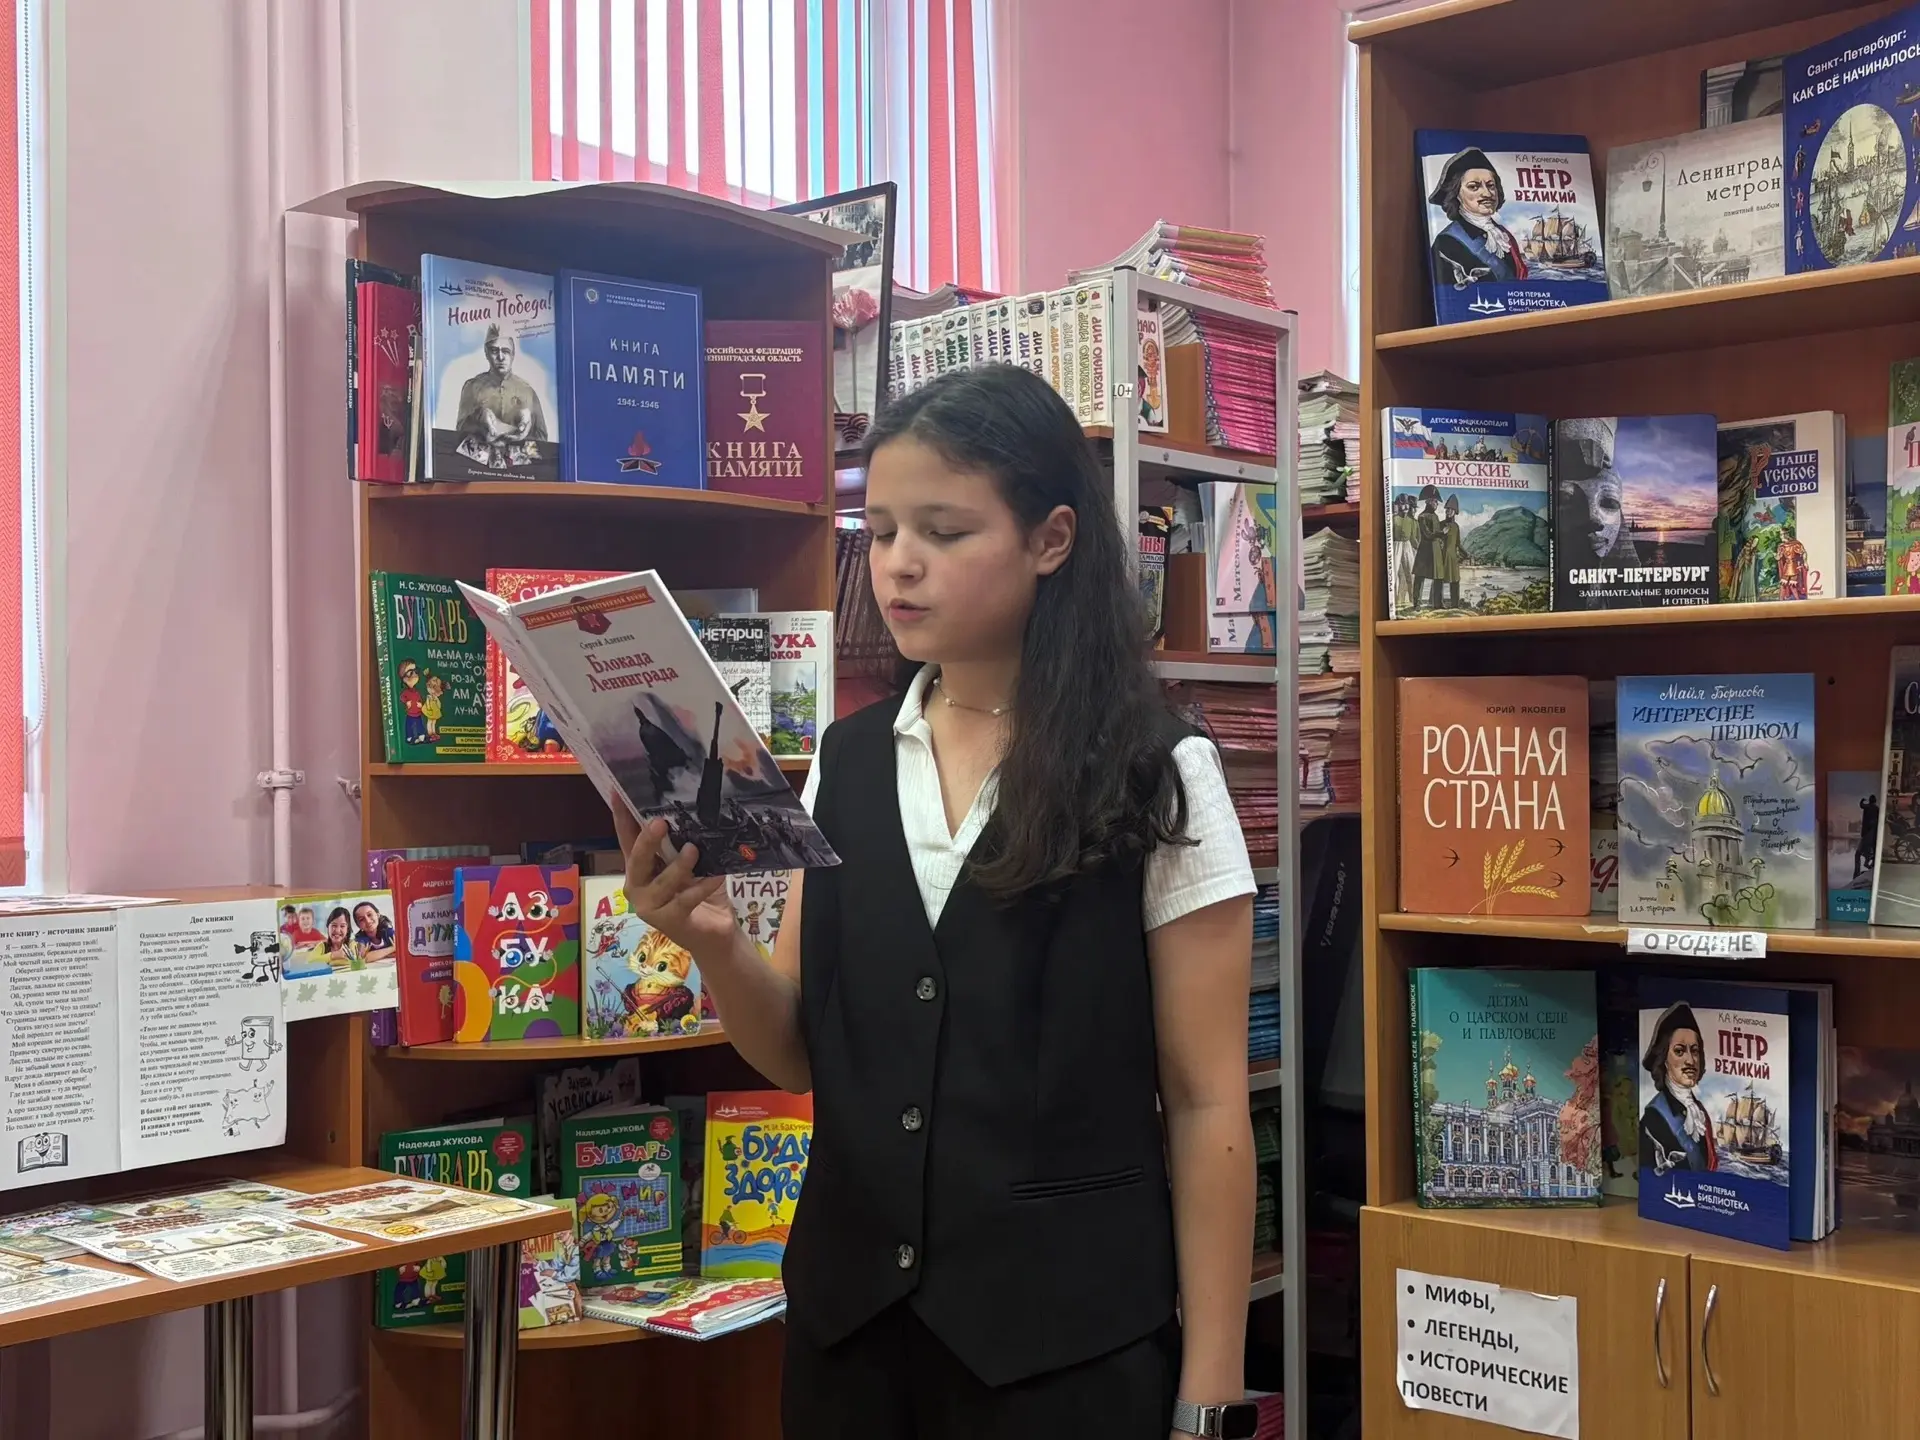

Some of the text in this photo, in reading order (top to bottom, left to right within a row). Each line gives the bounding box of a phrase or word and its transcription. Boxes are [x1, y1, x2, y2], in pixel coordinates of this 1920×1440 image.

[1807, 30, 1907, 77] Санкт-Петербург:
[1792, 85, 1815, 104] КАК
[1817, 74, 1840, 95] ВСЁ
[1531, 155, 1569, 165] Кочегаров
[1516, 165, 1572, 189] ПЁТР
[1677, 156, 1782, 186] Ленинград
[1514, 189, 1576, 203] ВЕЛИКИЙ
[1706, 178, 1781, 201] метрон
[465, 285, 504, 297] БИБЛИОТЕКА
[448, 290, 553, 326] Наша Победа!
[1508, 298, 1568, 308] БИБЛИОТЕКА
[1079, 312, 1089, 341] МИР
[610, 338, 660, 356] КНИГА
[705, 346, 754, 354] ОССИЙСКАЯ
[988, 329, 998, 357] МИР
[1001, 327, 1011, 356] МИР
[1019, 332, 1030, 359] МИР
[1033, 331, 1042, 356] МИР
[768, 355, 802, 363] ОБЛАСТЬ
[1092, 316, 1104, 411] Я ПОЗНАЮ МИР
[589, 361, 685, 390] ПАМЯТИ
[1459, 419, 1508, 427] ЭНЦИКЛОПЕДИЯ
[706, 442, 803, 459] КНИГА
[1776, 453, 1817, 466] НАШЕ
[706, 460, 803, 478] ПАМЯТИ
[1434, 461, 1511, 478] РУССКИЕ
[1417, 476, 1529, 489] ПУТЕШЕСТВЕННИКИ
[1771, 481, 1817, 494] СЛОВО
[1233, 500, 1243, 601] Математика
[1569, 566, 1710, 585] САНКТ-ПЕТЕРБУРГ
[1809, 571, 1823, 591] 2
[418, 583, 453, 593] ЖУКОВА
[1579, 587, 1709, 598] ЗАНИМАТЕЛЬНЫЕ ВОПРОСЫ
[1671, 597, 1709, 605] ОТВЕТЫ
[394, 595, 467, 643] БУКВАРЬ
[580, 633, 635, 650] Сергей Алексеев
[699, 628, 763, 641] НЕТАРИЙ
[771, 633, 816, 648] УКА
[428, 649, 460, 660] МА-МА
[585, 652, 654, 674] Блокада
[771, 650, 802, 660] ОКОВ
[461, 661, 472, 669] УС
[452, 675, 475, 683] РО-ЗА
[586, 667, 679, 693] Ленинграда
[453, 688, 470, 699] АМ
[1660, 683, 1765, 701] Майя Борисова
[455, 706, 479, 715] ЛУ-НА
[1486, 706, 1566, 714] ЮРИЙ ЯКОВЛЕВ
[1632, 704, 1755, 723] ИНТЕРЕСНЕЕ
[1710, 722, 1800, 741] ПЕШКОМ
[1423, 724, 1567, 777] РОДНАЯ
[1424, 778, 1565, 830] СТРАНА
[422, 911, 436, 919] КАК
[499, 891, 549, 921] АЗ
[1845, 903, 1852, 912] 3
[190, 915, 234, 924] Две книжки
[16, 929, 39, 937] книгу
[48, 928, 85, 936] источник
[1644, 933, 1659, 950] О
[500, 937, 548, 967] БУ
[499, 984, 549, 1014] КА
[1487, 995, 1528, 1008] ДЕТЯМ
[1449, 1012, 1568, 1025] О ЦАРСКОМ СЕЛЕ
[1733, 1014, 1767, 1028] Кочегаров
[1462, 1028, 1556, 1040] И ПАВЛОВСКЕ
[1718, 1027, 1768, 1060] ПЁТР
[1714, 1058, 1770, 1080] ВЕЛИКИЙ
[576, 1124, 645, 1137] Надежда ЖУКОВА
[398, 1135, 483, 1149] Надежда ЖУКОВА
[575, 1141, 672, 1168] БУКВАРЬ
[724, 1163, 807, 1205] ЗДОРО
[1698, 1184, 1736, 1197] МОЯ ПЕРВАЯ
[1698, 1192, 1749, 1211] БИБЛИОТЕКА
[1425, 1284, 1495, 1314] МИФЫ,
[1424, 1318, 1519, 1353] ЛЕГЕНДЫ,
[1420, 1350, 1568, 1393] ИСТОРИЧЕСКИЕ
[1402, 1380, 1488, 1411] ПОВЕСТИ
